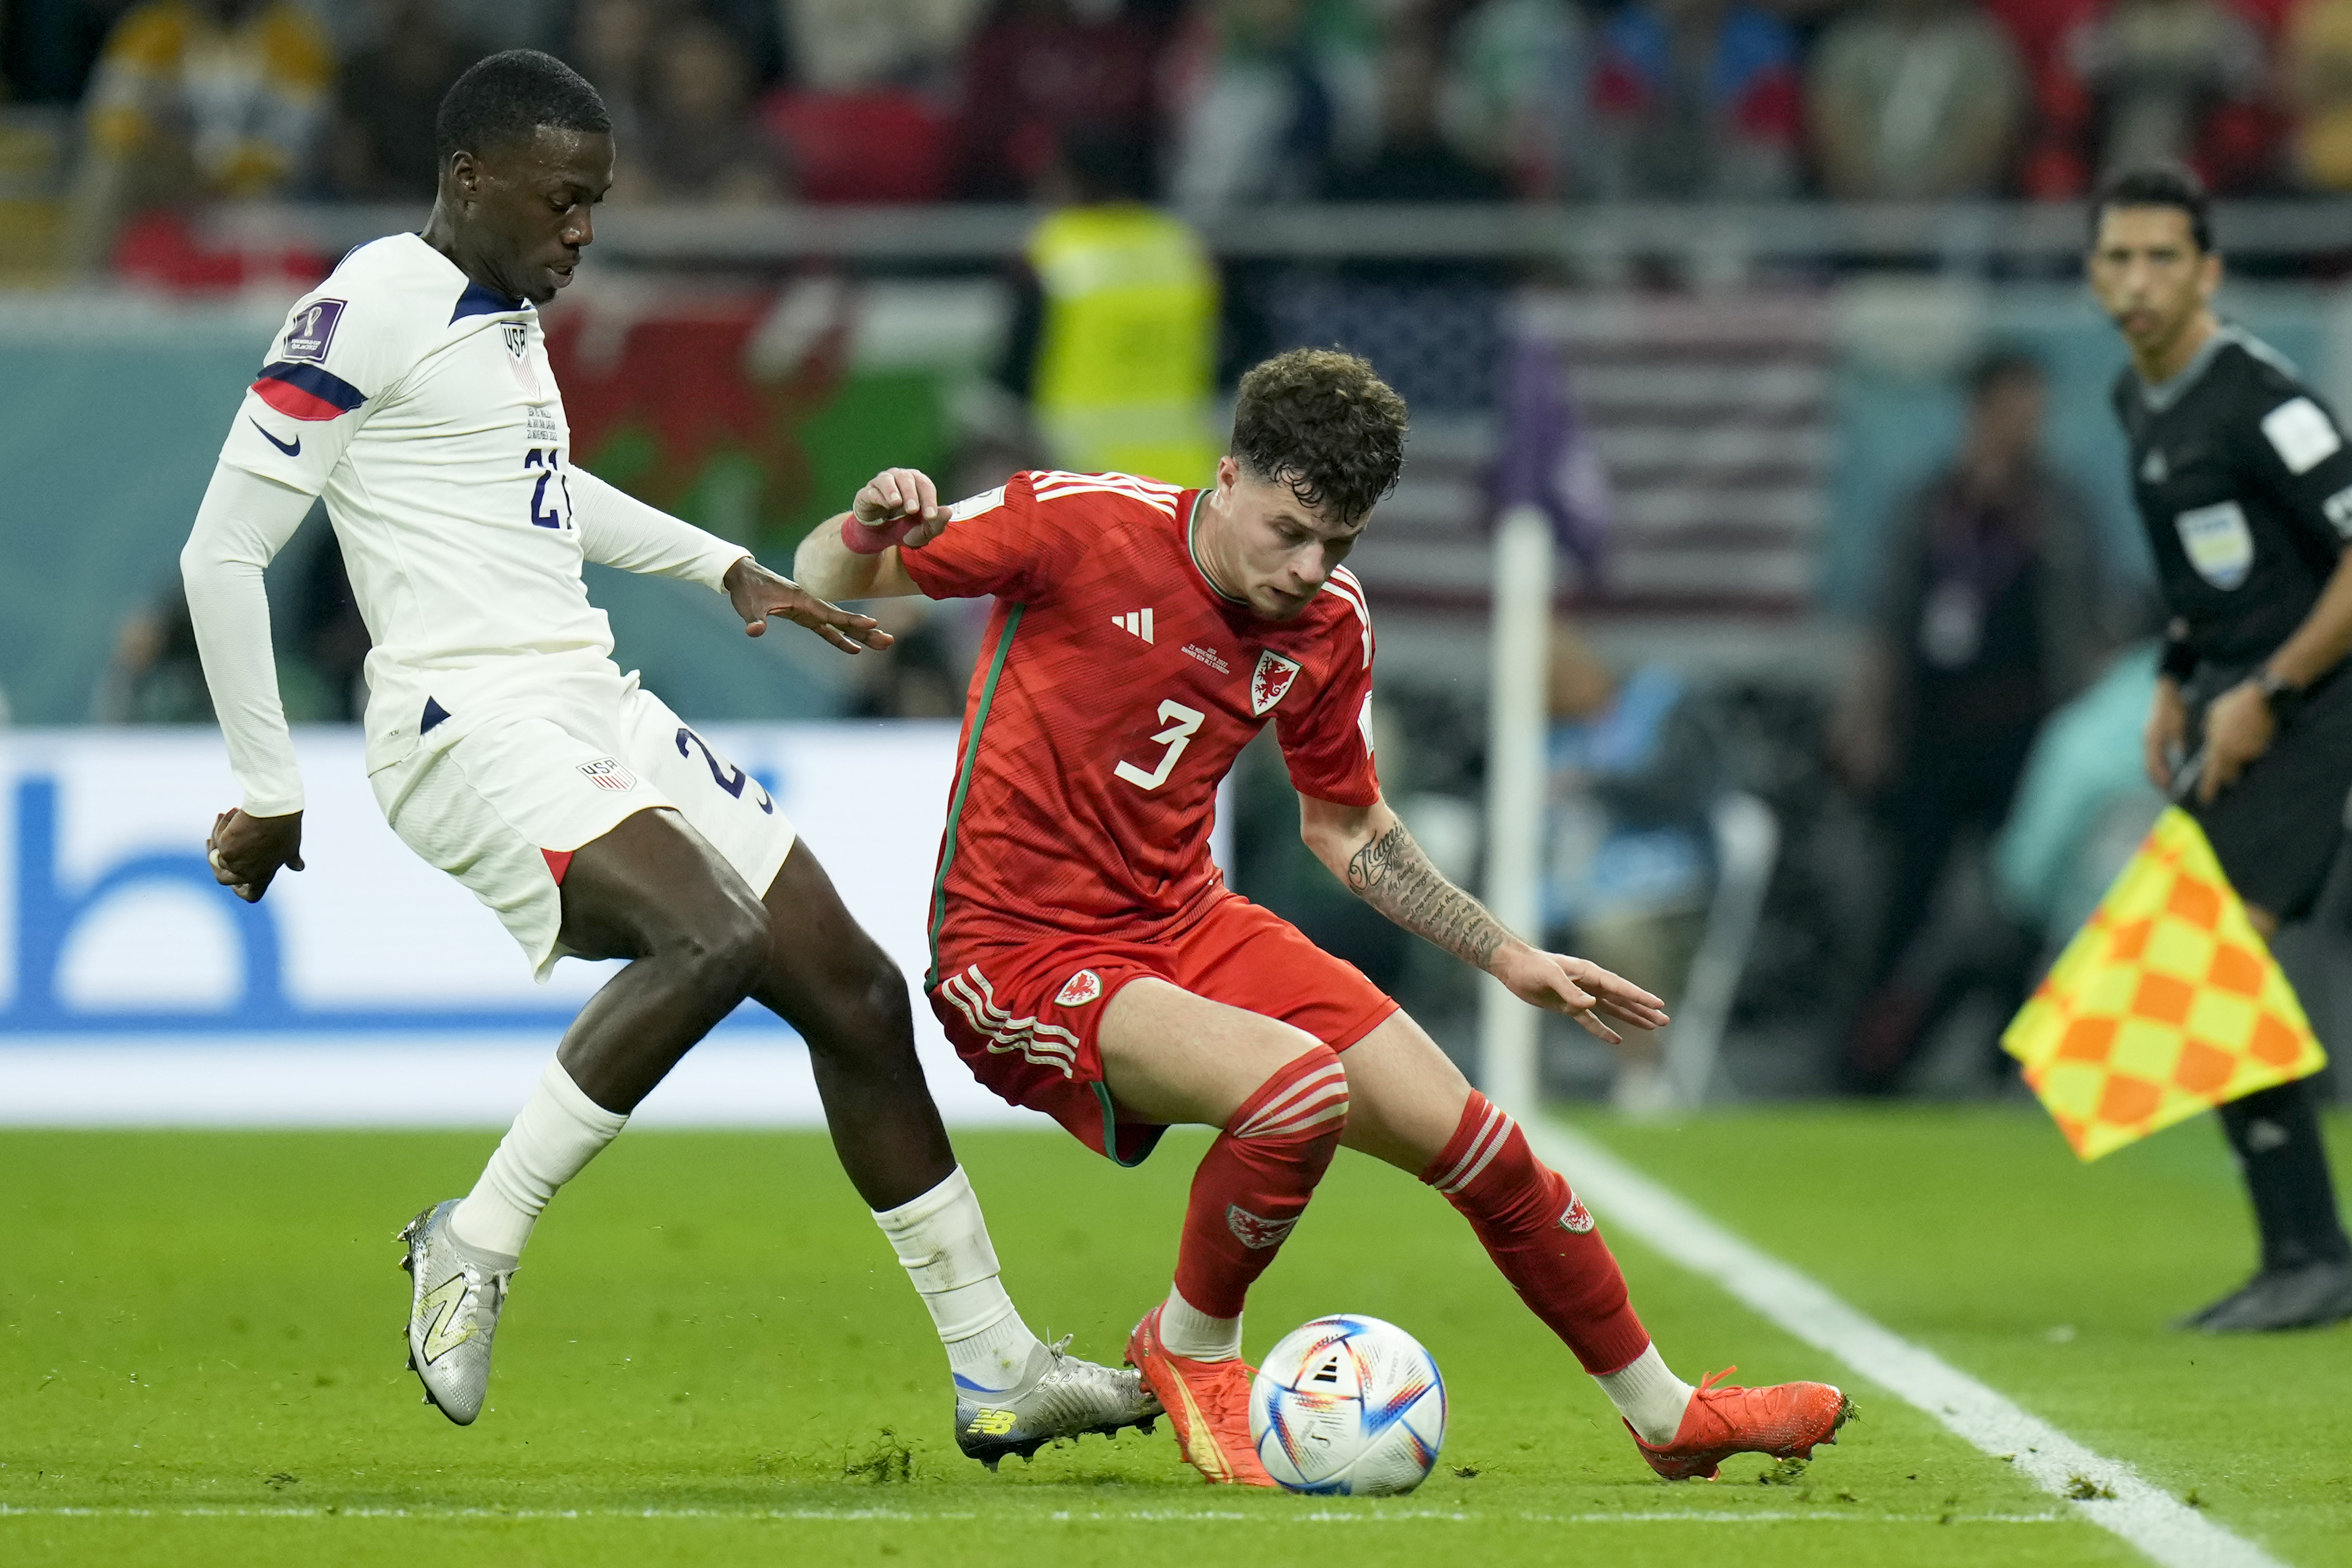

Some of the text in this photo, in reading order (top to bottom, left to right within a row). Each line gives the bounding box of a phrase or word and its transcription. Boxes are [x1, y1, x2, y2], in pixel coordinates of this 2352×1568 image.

[504, 328, 526, 358] USA
[1114, 699, 1205, 791] 3
[581, 760, 618, 774] USA
